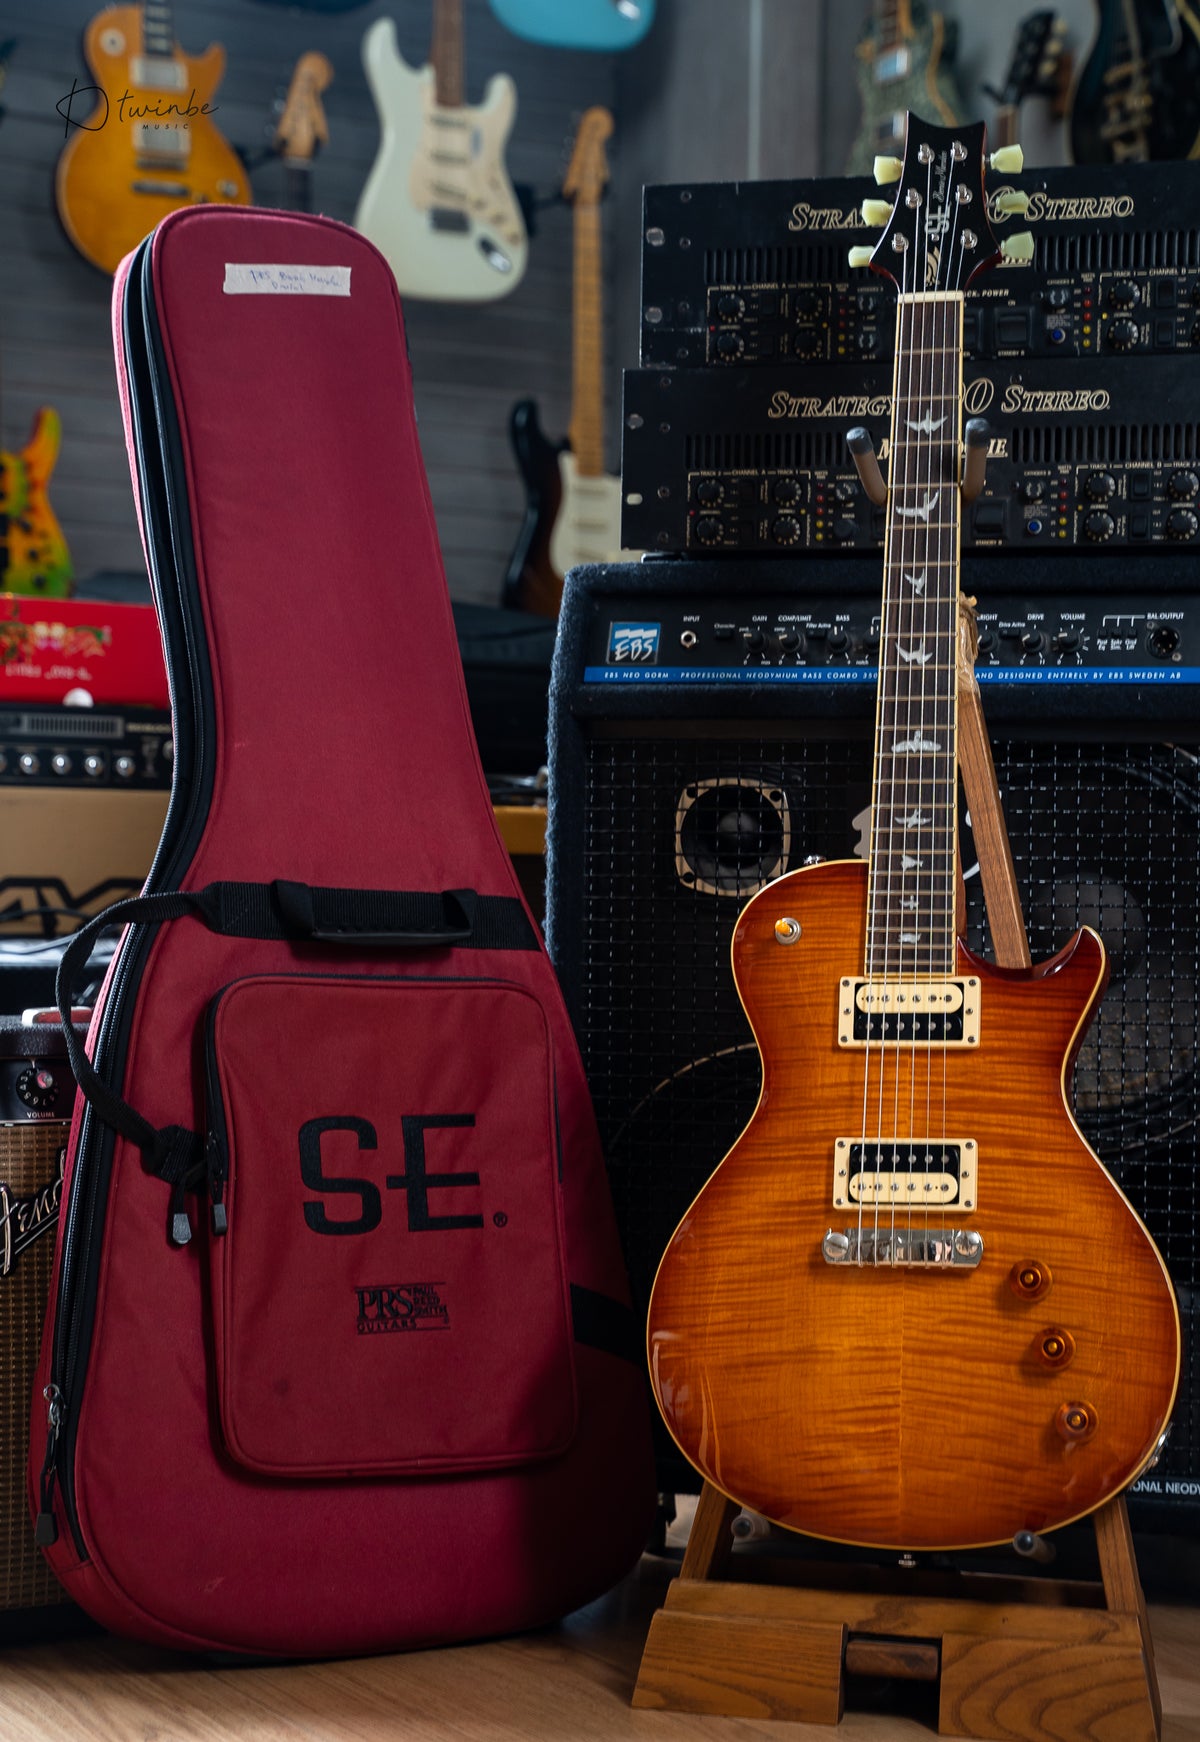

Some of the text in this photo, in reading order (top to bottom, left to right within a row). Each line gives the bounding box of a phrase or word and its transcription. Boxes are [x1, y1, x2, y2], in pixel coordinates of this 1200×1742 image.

[1149, 268, 1178, 276] CHANNEL
[982, 289, 1009, 298] POWER
[1125, 461, 1154, 469] CHANNEL
[731, 469, 759, 477] CHANNEL
[836, 614, 850, 622] BASS
[615, 638, 654, 661] EBS
[26, 1111, 55, 1119] VOLUME
[355, 1288, 413, 1319] PRS
[357, 1317, 417, 1333] GUITARS
